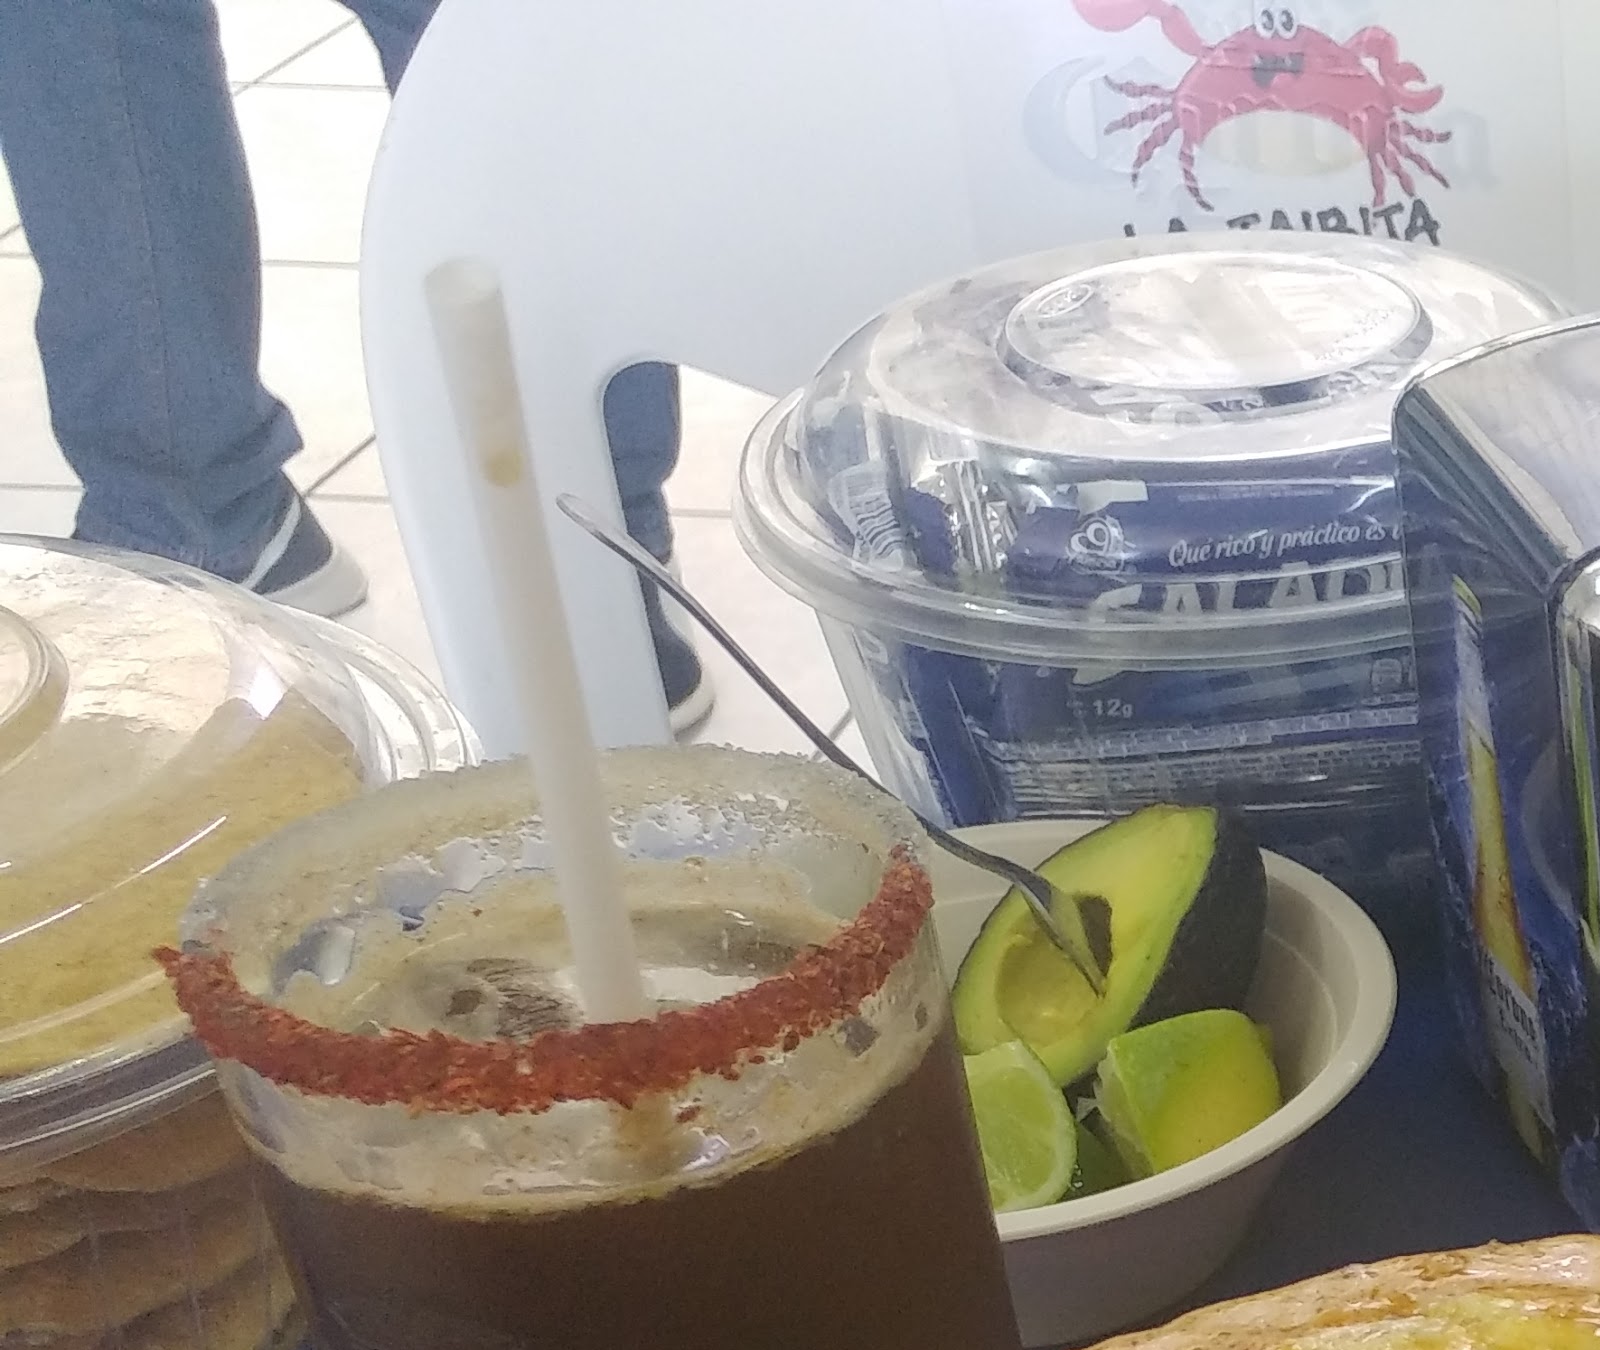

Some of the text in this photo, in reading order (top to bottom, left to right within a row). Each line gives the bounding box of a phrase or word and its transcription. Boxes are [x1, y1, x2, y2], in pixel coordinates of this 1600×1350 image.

[1168, 537, 1211, 567] Qué
[1259, 534, 1274, 560] y
[1277, 520, 1360, 557] práctico
